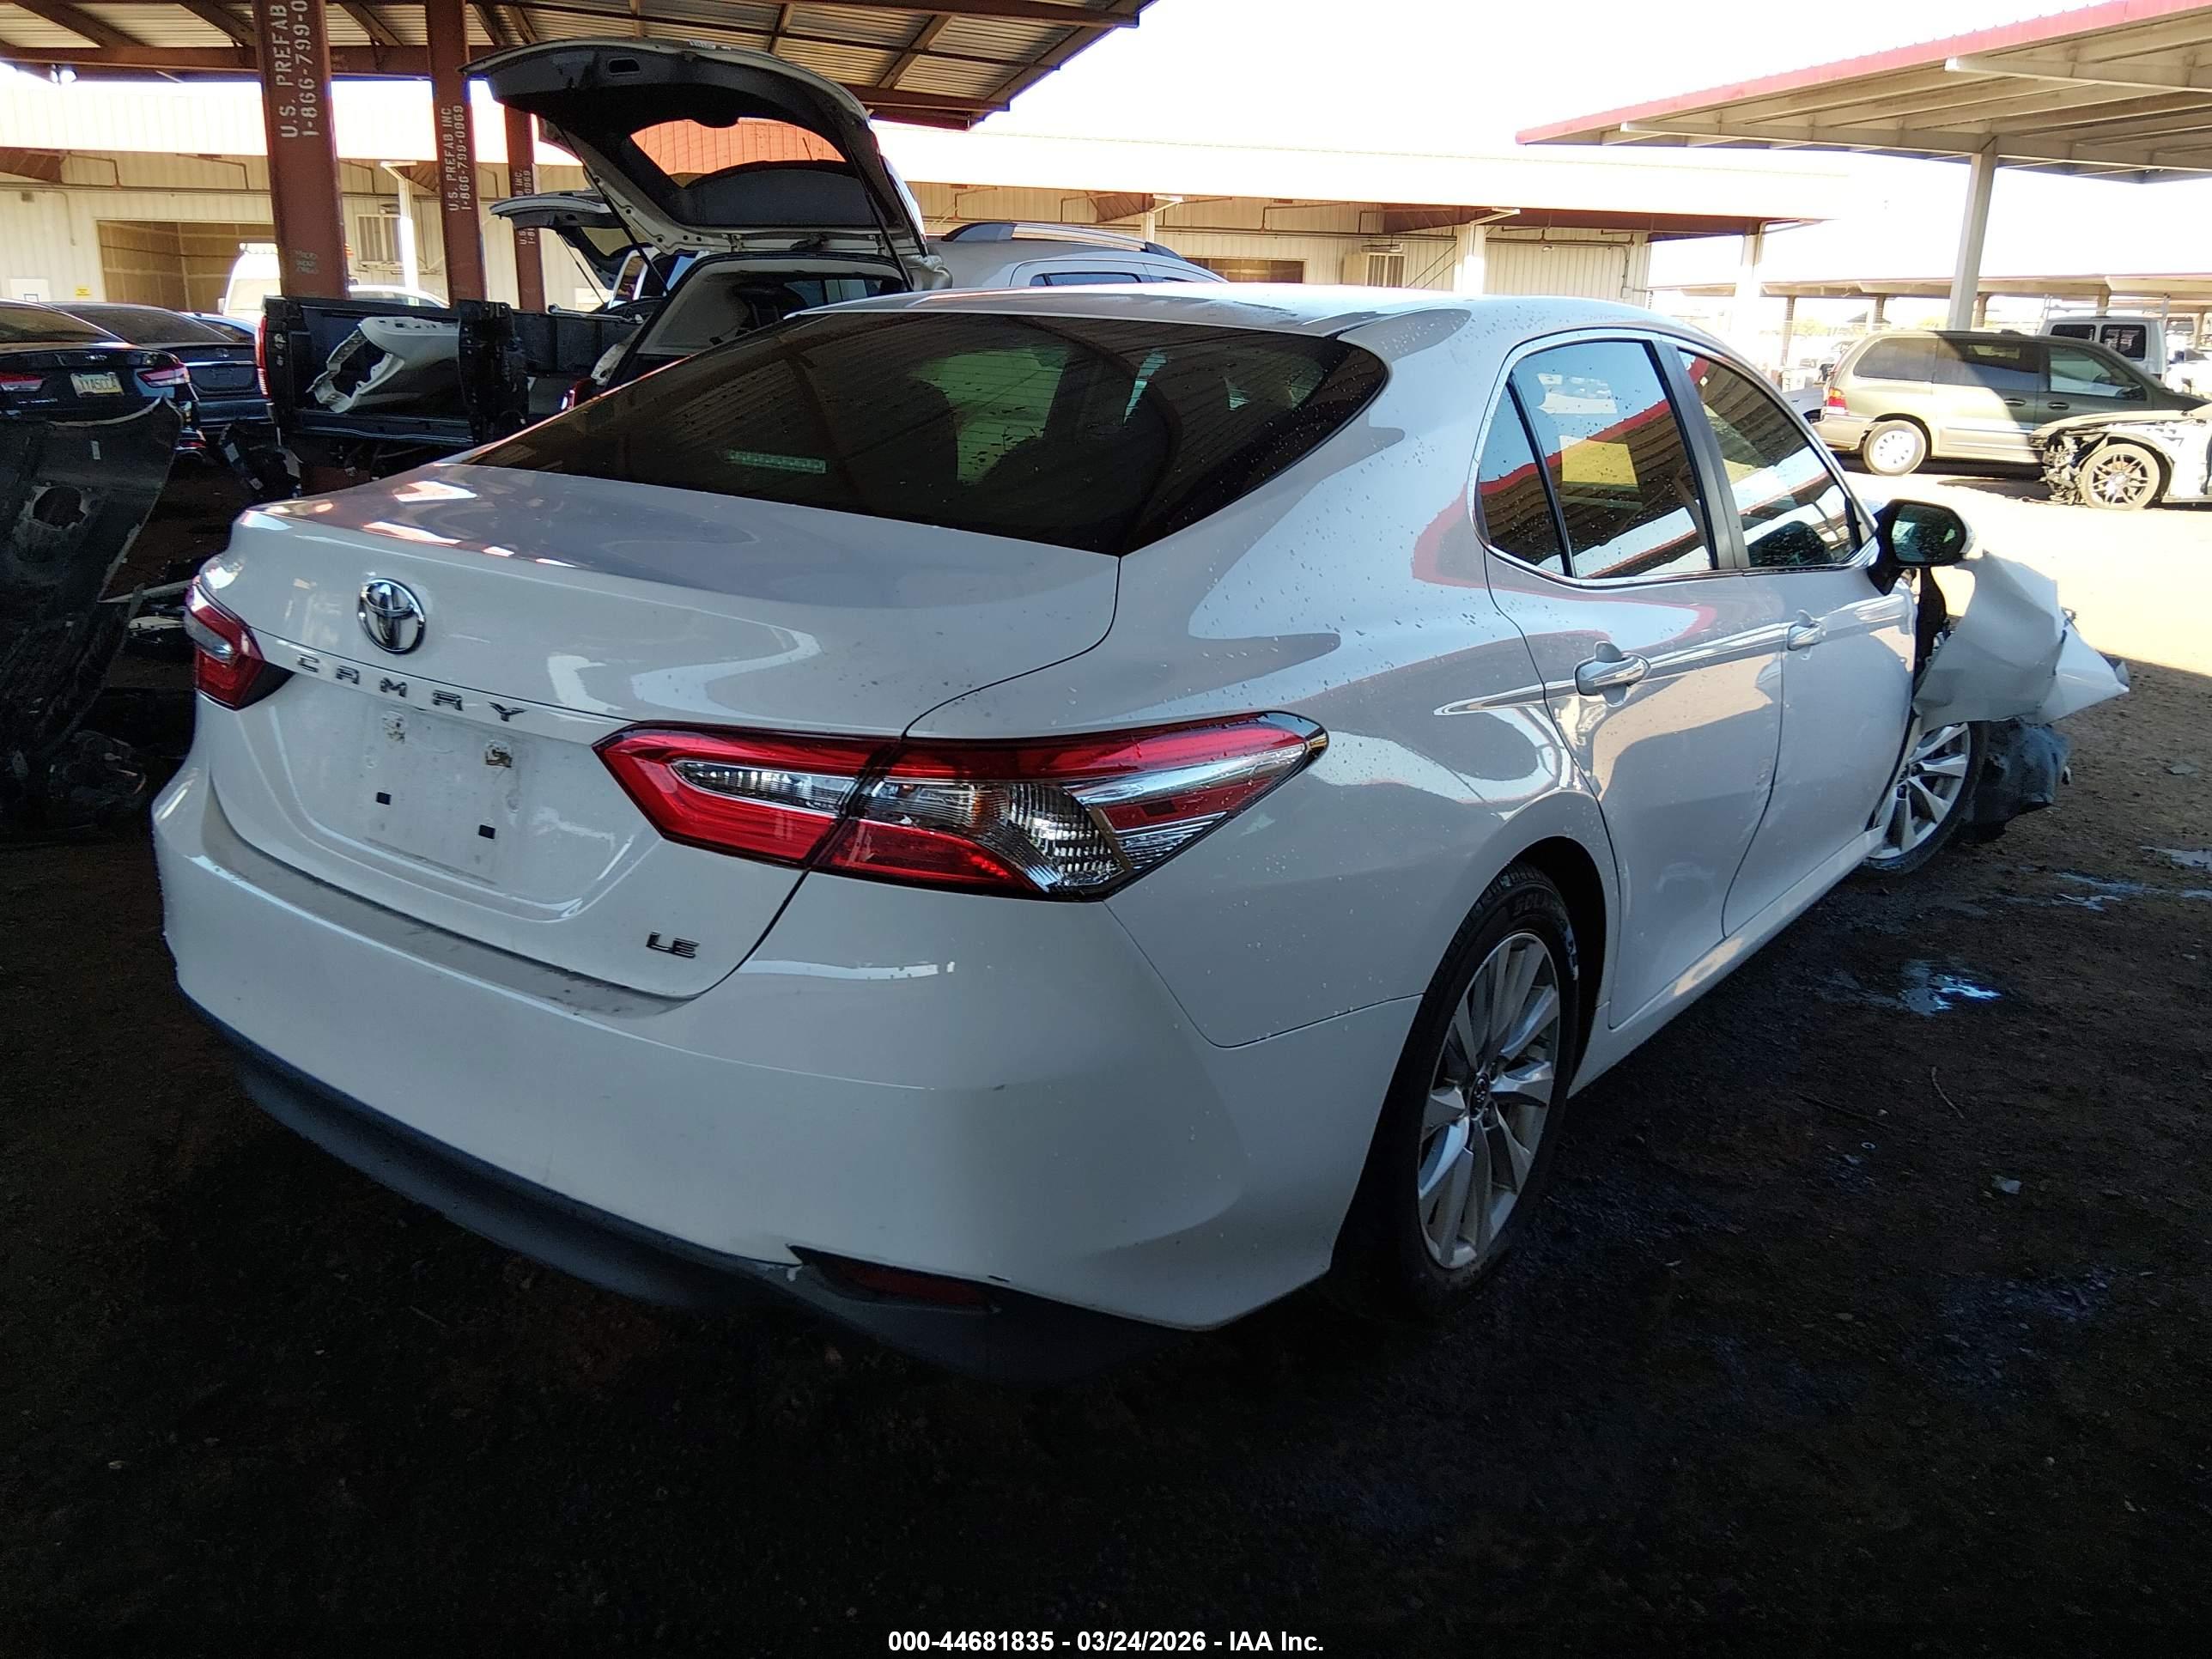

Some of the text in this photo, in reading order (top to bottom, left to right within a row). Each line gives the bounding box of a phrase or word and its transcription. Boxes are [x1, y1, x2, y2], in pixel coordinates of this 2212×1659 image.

[269, 4, 299, 138] U.S. PREFAB
[442, 134, 457, 182] PREFAB
[297, 653, 529, 723] CAMRY
[645, 931, 702, 959] LE
